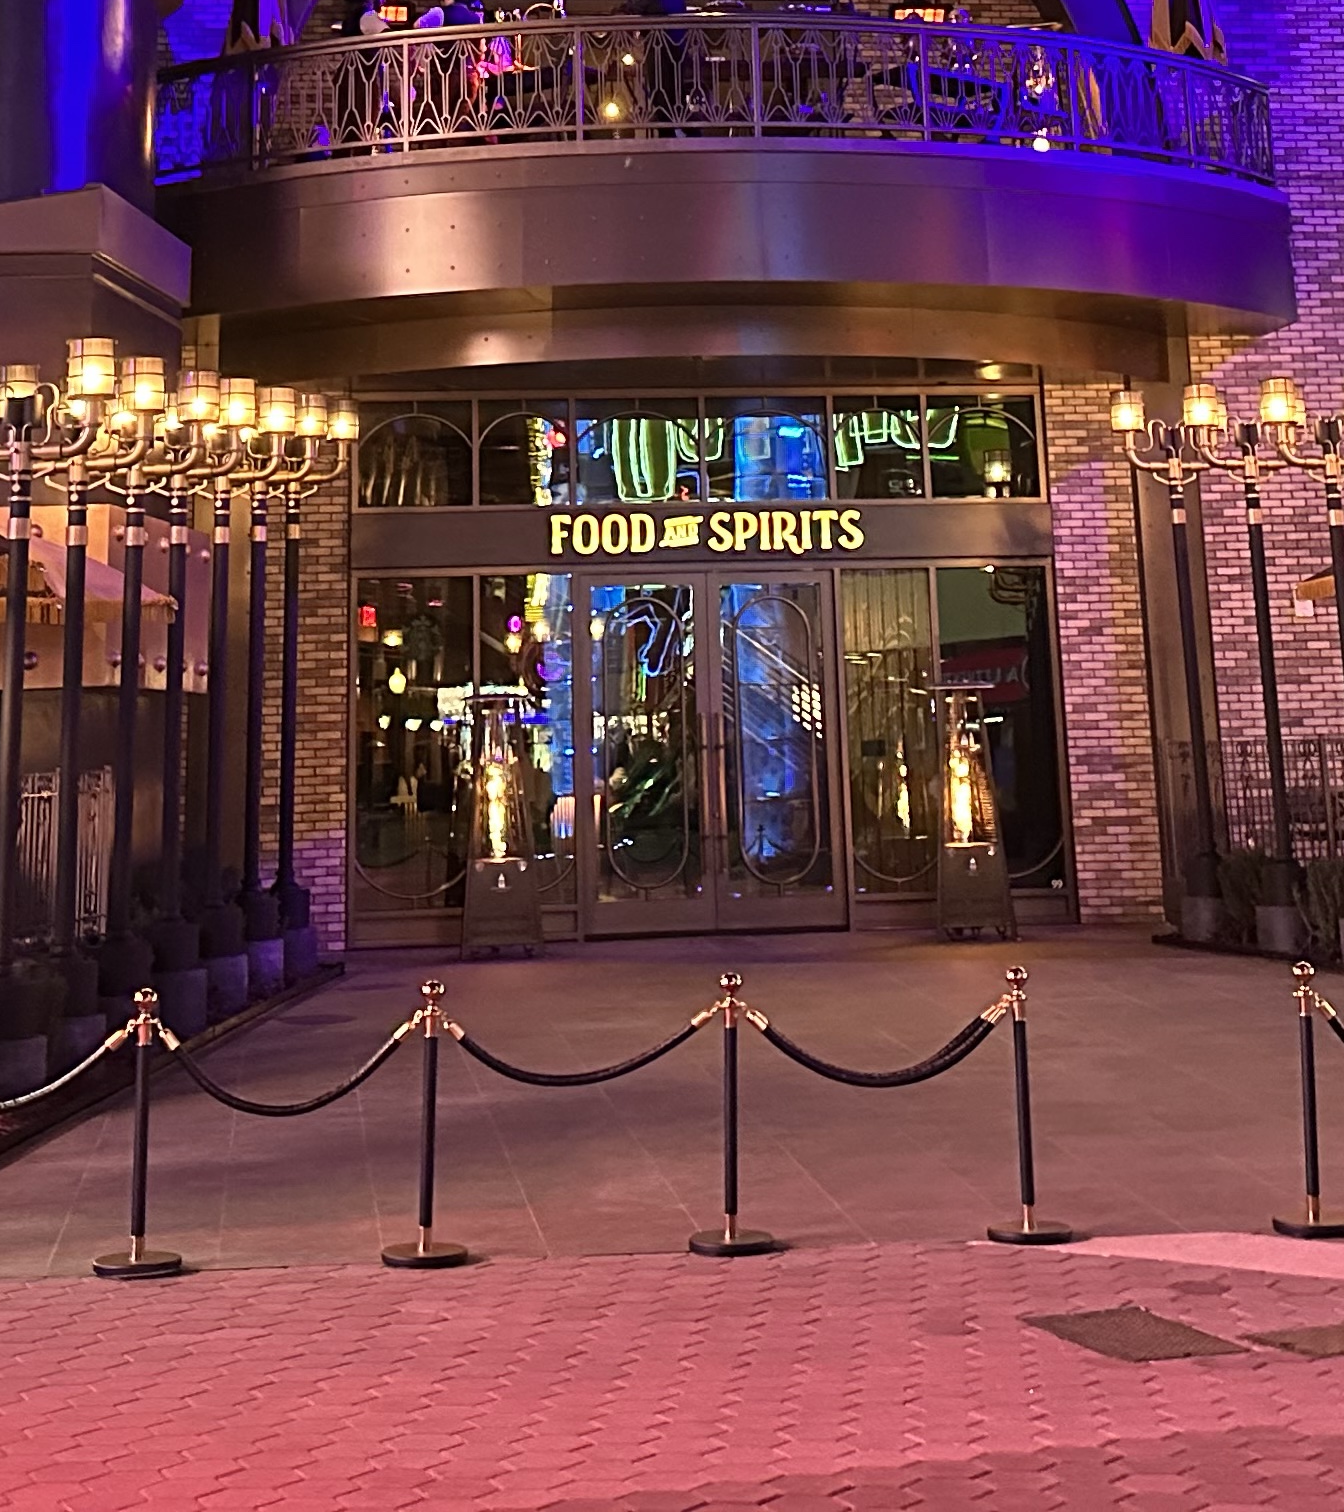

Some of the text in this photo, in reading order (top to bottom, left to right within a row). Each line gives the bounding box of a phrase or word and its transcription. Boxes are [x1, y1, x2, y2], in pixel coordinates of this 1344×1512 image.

[550, 509, 865, 555] FOOD AND SPIRITS
